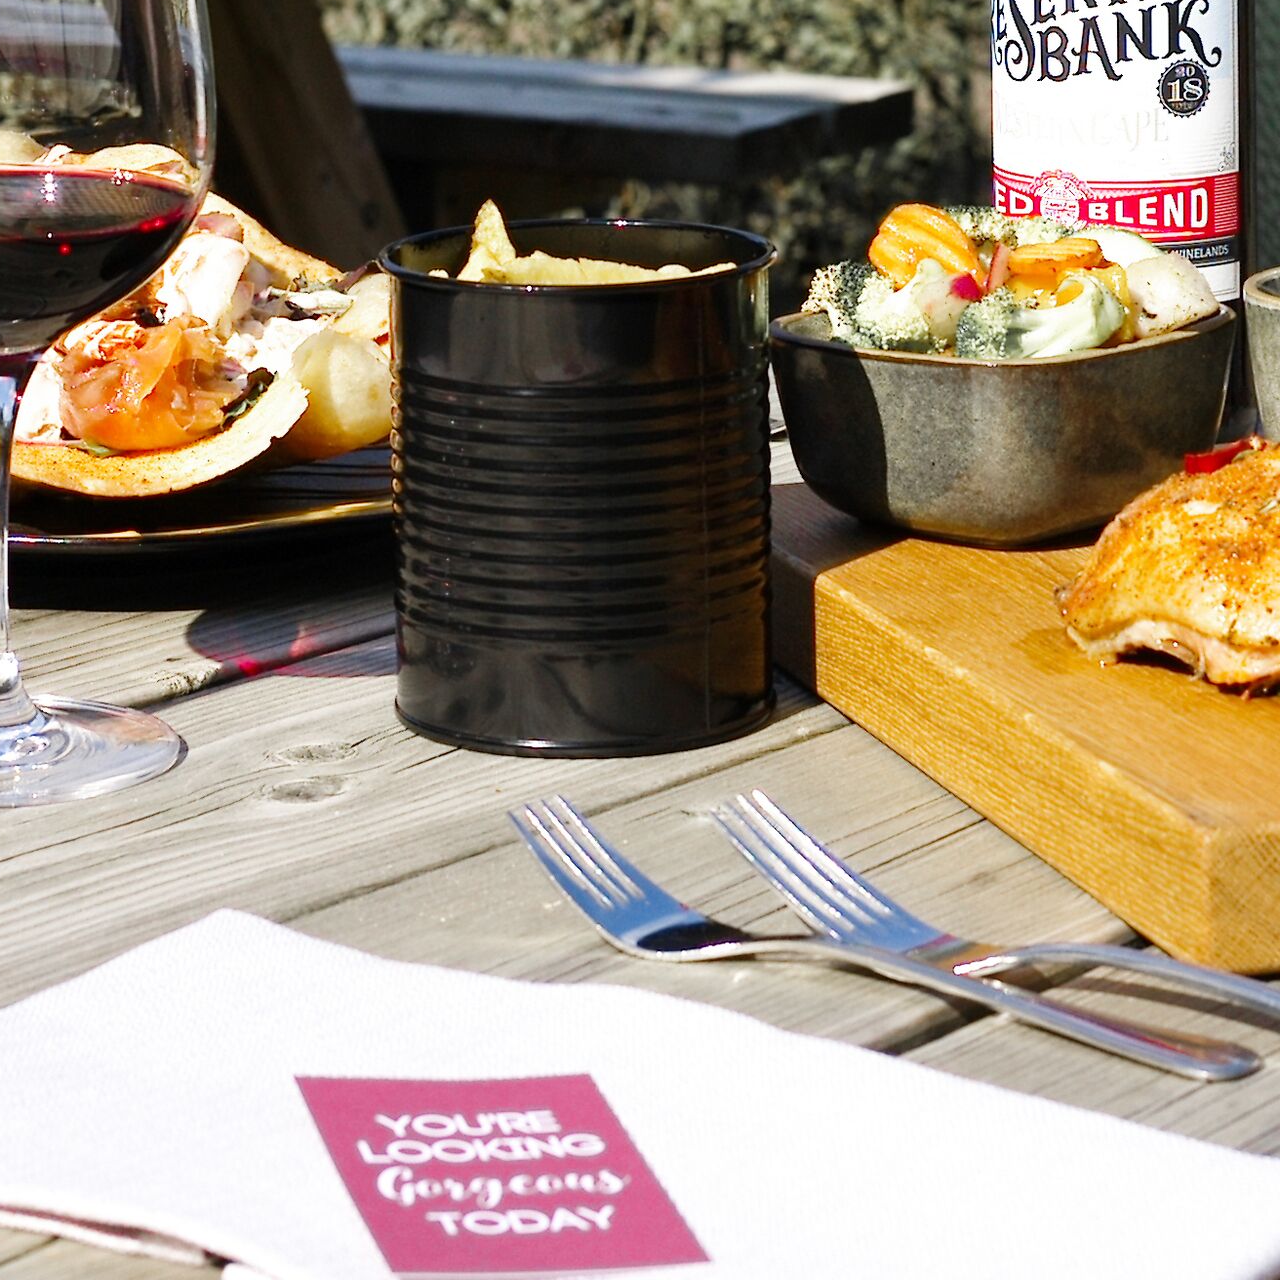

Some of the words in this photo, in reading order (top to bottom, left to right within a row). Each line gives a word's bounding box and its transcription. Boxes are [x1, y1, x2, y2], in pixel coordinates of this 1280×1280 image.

[1167, 78, 1204, 102] 18
[993, 179, 1034, 215] ED
[1088, 187, 1209, 230] BLEND
[374, 1109, 562, 1138] YOU'RE
[357, 1133, 606, 1164] LOOKING
[376, 1165, 631, 1208] Gorgeous
[425, 1204, 615, 1236] TODAY
